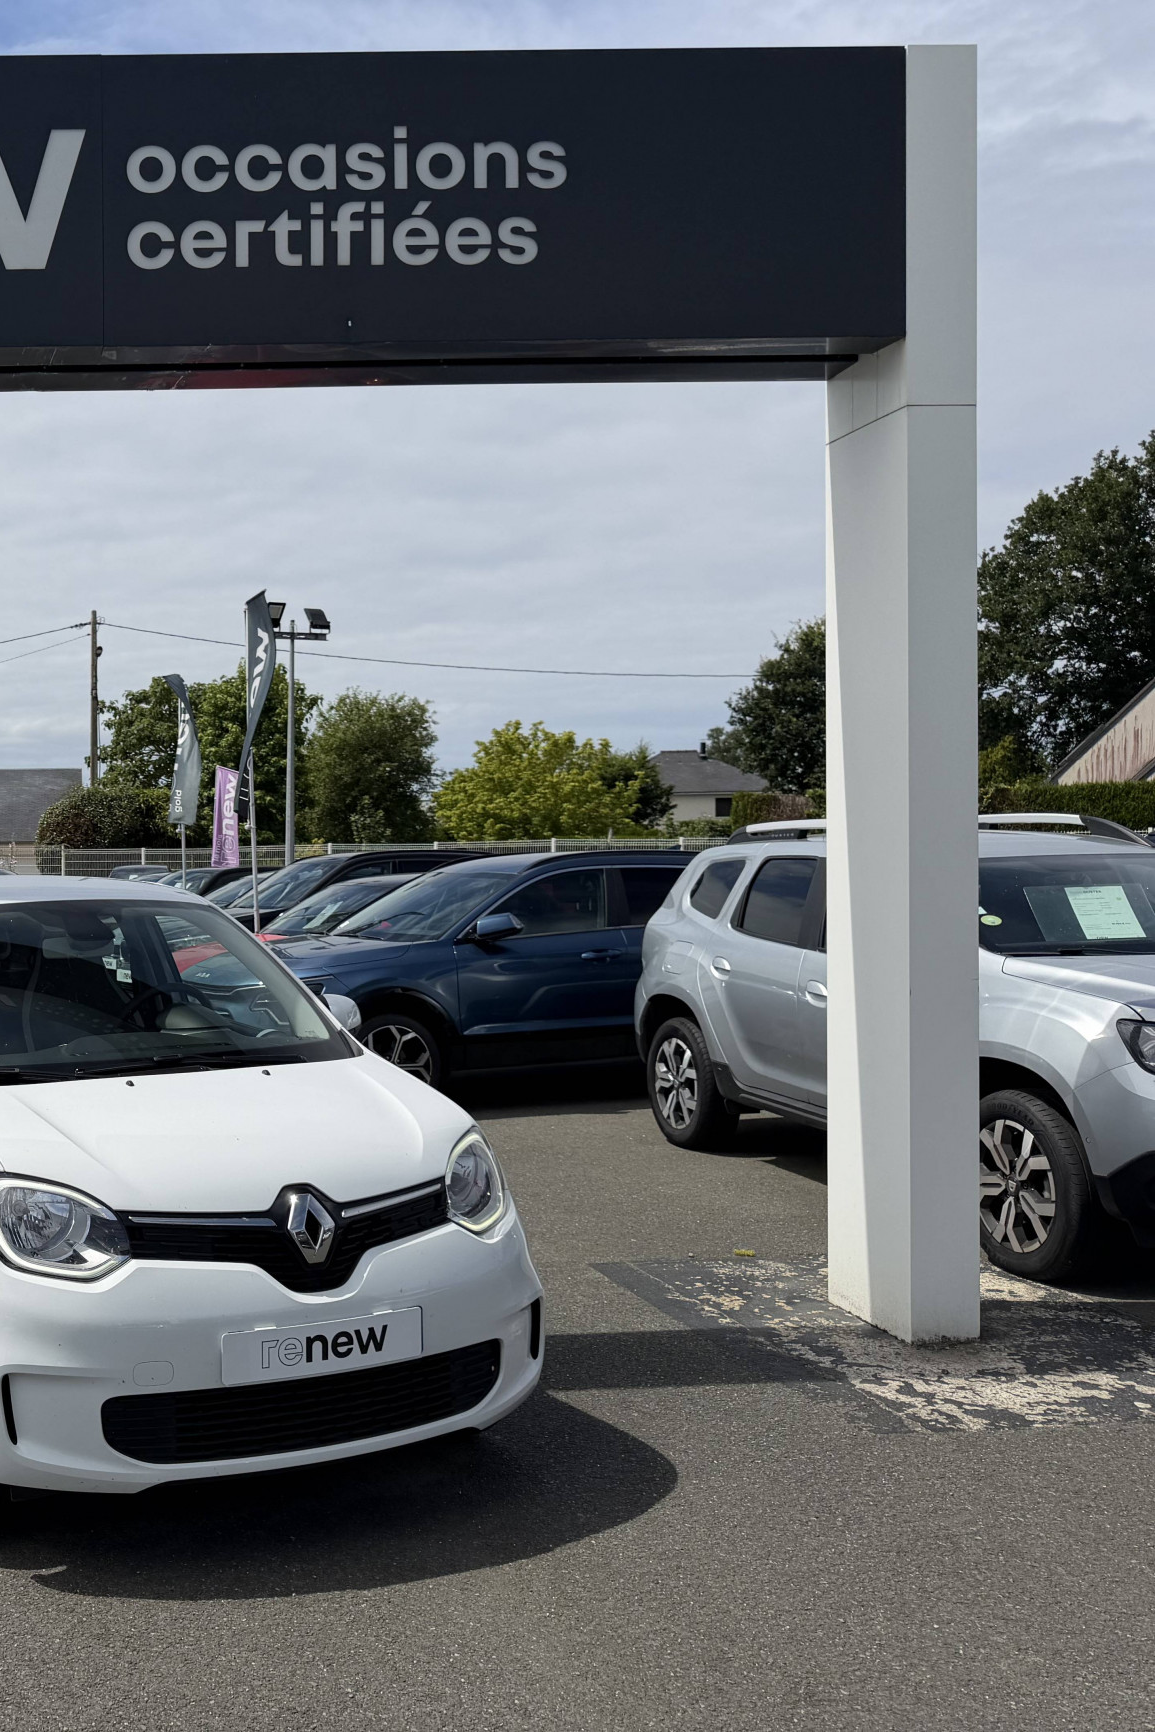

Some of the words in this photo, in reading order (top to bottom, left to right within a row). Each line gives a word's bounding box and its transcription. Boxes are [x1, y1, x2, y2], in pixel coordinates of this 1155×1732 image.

[126, 125, 568, 194] occasions
[126, 200, 539, 270] certifiées
[174, 789, 183, 813] gold
[261, 1324, 389, 1370] renew
